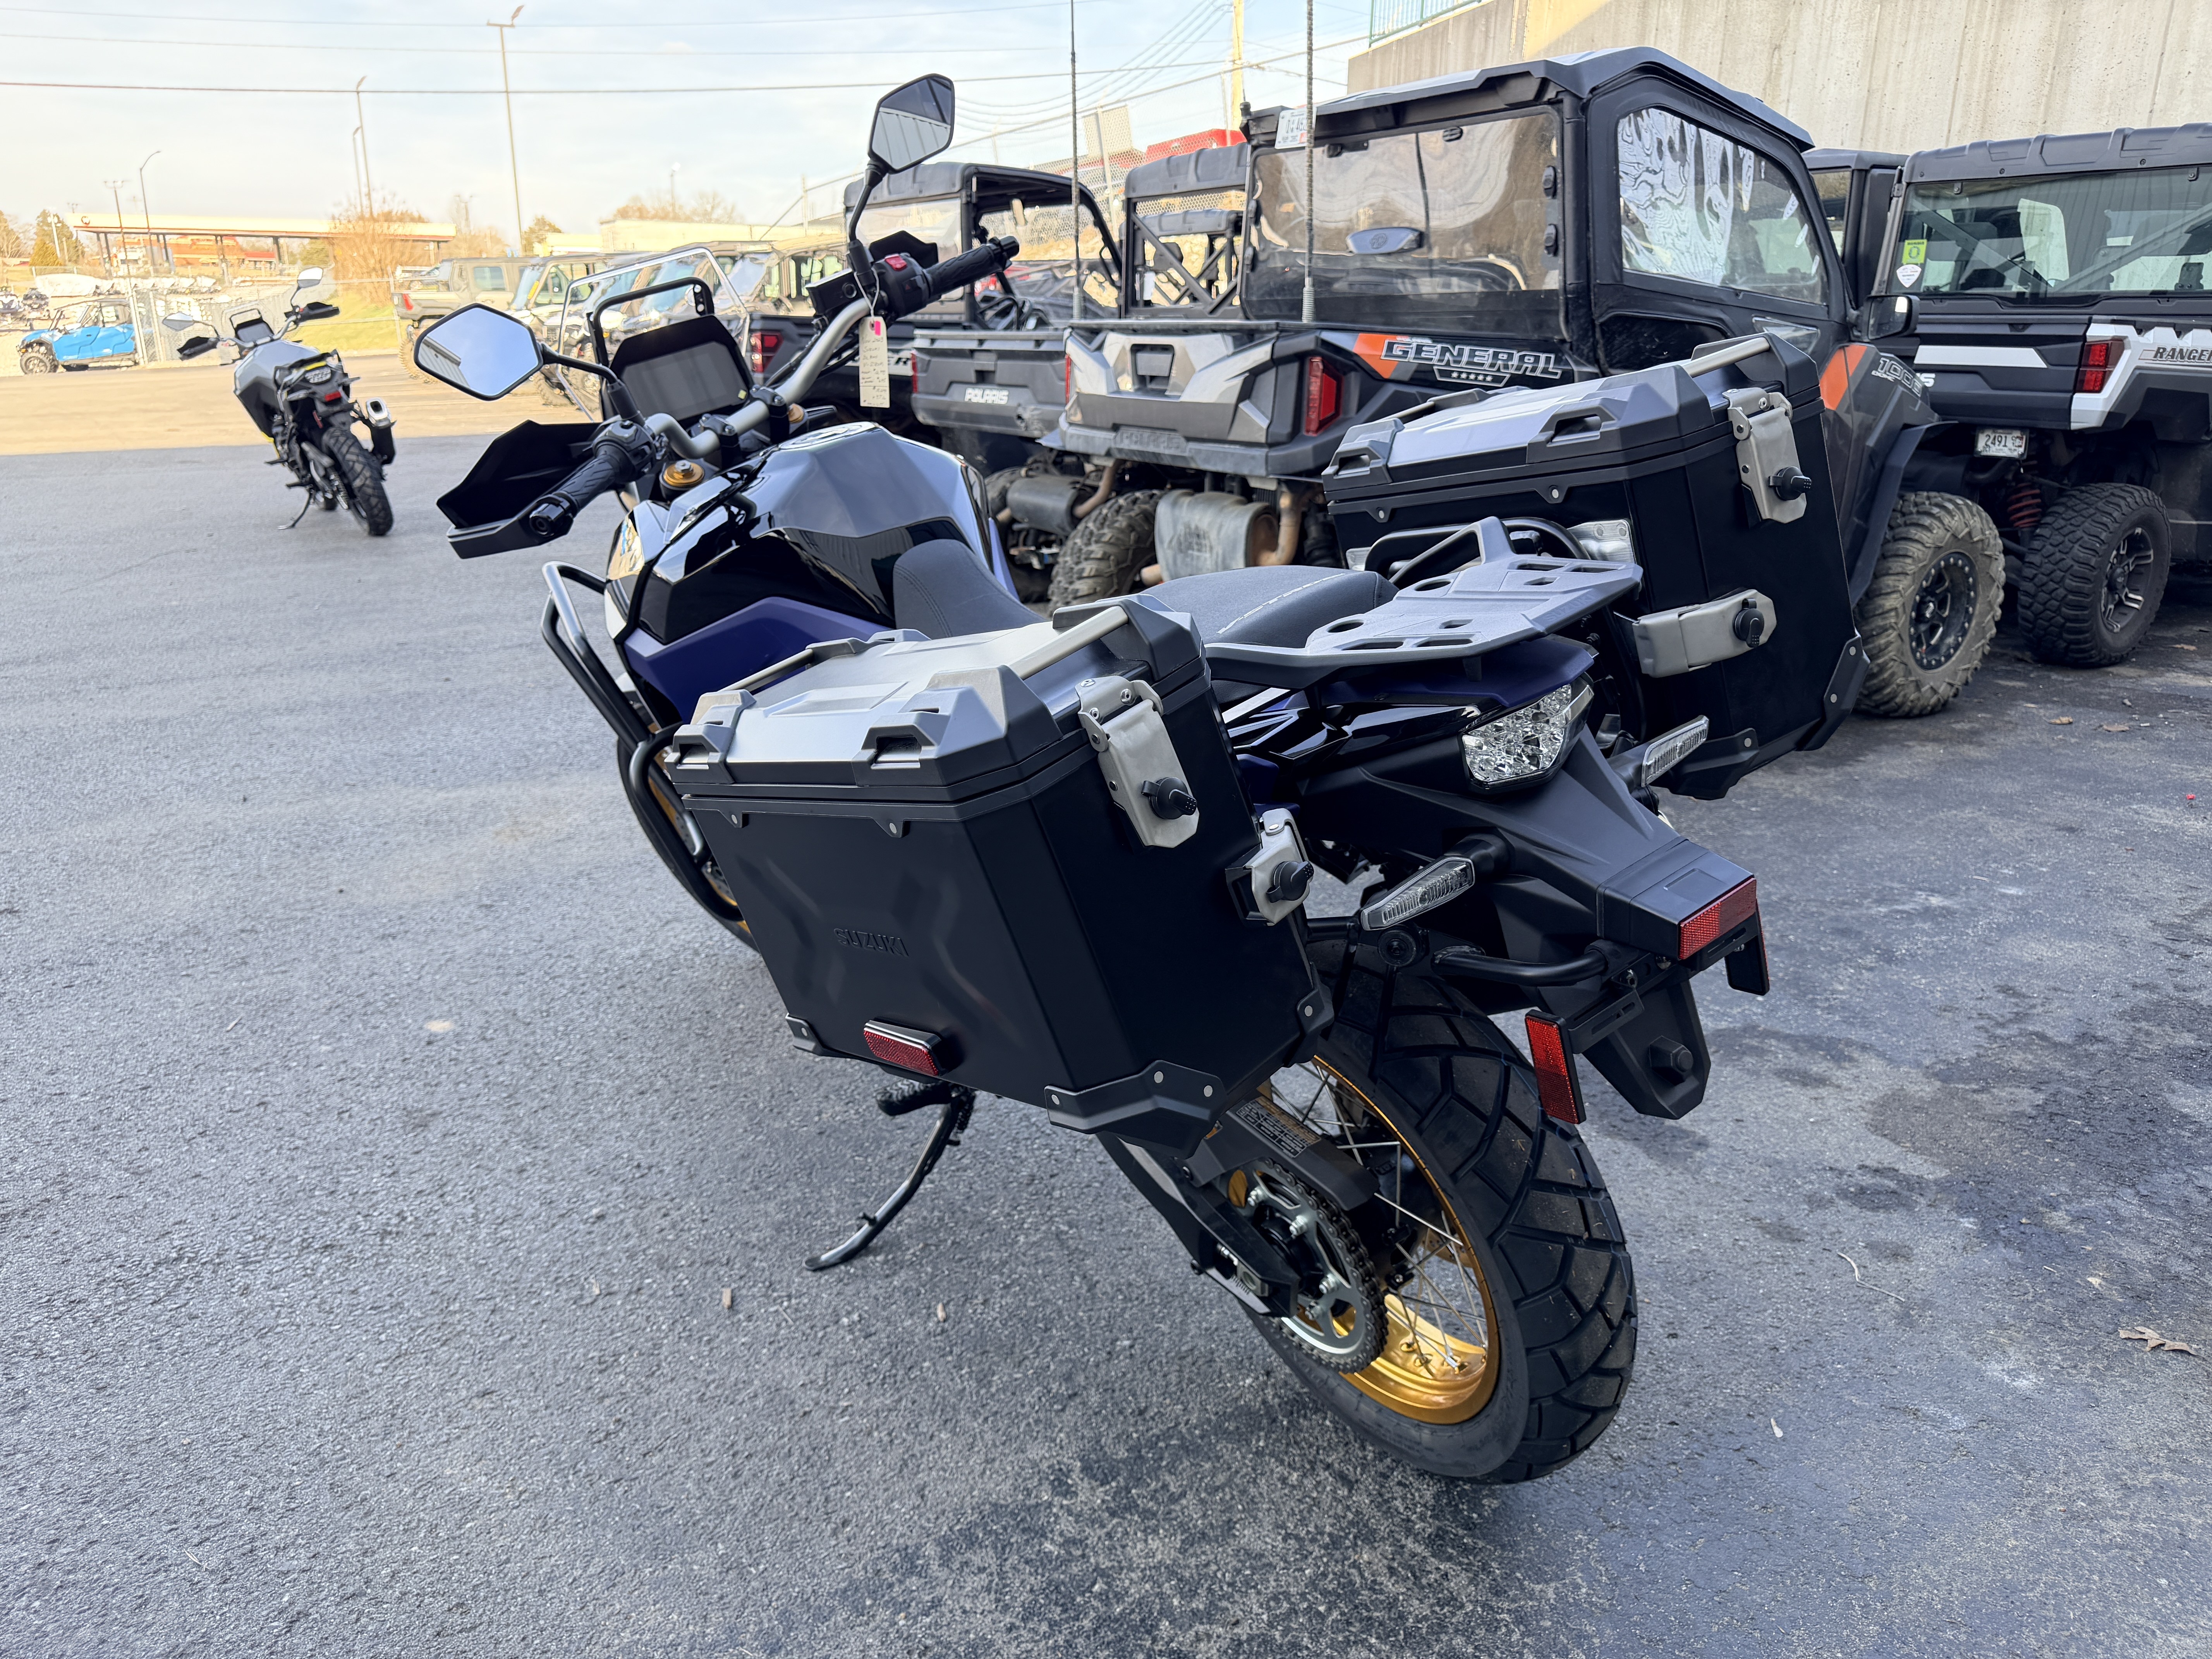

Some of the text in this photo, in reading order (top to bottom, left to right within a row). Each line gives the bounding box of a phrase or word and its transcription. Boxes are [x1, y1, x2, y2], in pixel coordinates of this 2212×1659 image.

[1380, 339, 1563, 379] GENERAL
[1878, 357, 1923, 397] 1000
[964, 388, 1009, 405] POLARIS
[1543, 593, 1595, 620] SUZUKI
[834, 928, 909, 957] SUZUKI
